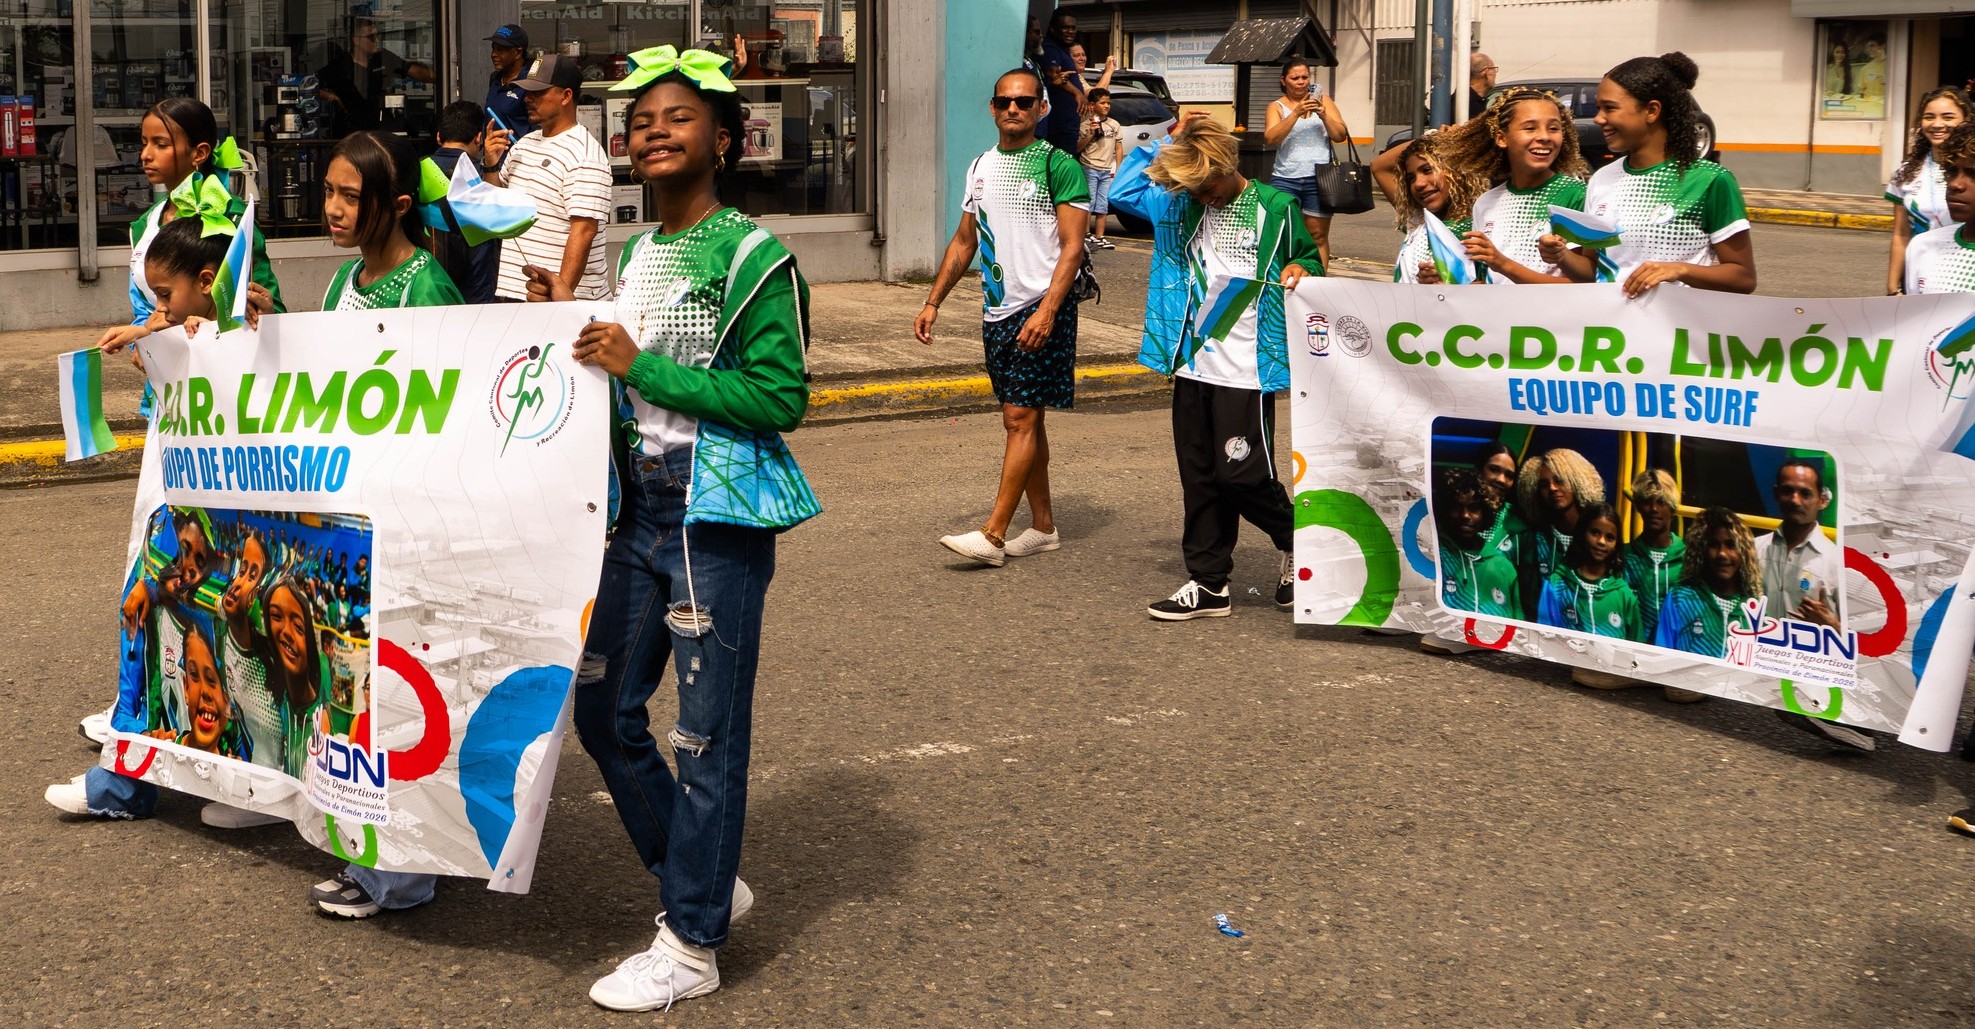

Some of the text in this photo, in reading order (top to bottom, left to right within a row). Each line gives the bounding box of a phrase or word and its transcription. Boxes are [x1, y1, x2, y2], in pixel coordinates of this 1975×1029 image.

[1386, 321, 1894, 392] C.C.D.R. LIMÓN
[237, 350, 461, 436] LIMÓN
[489, 347, 528, 428] Comité Cantonal de Deportes
[569, 401, 574, 411] de
[1508, 378, 1759, 427] EQUIPO DE SURF
[198, 447, 223, 491] DE
[222, 445, 351, 492] PORRISMO
[1727, 640, 1754, 667] XLII
[1758, 621, 1855, 660] JDN
[1756, 645, 1855, 670] Juegos Deportivos
[1754, 661, 1790, 674] Provincia
[1792, 668, 1802, 676] de
[1832, 677, 1855, 687] 2026
[332, 779, 386, 800] Deportivos
[336, 793, 386, 811] Paranacionales
[332, 802, 340, 810] de
[341, 805, 362, 818] Limón
[364, 812, 387, 823] 2026
